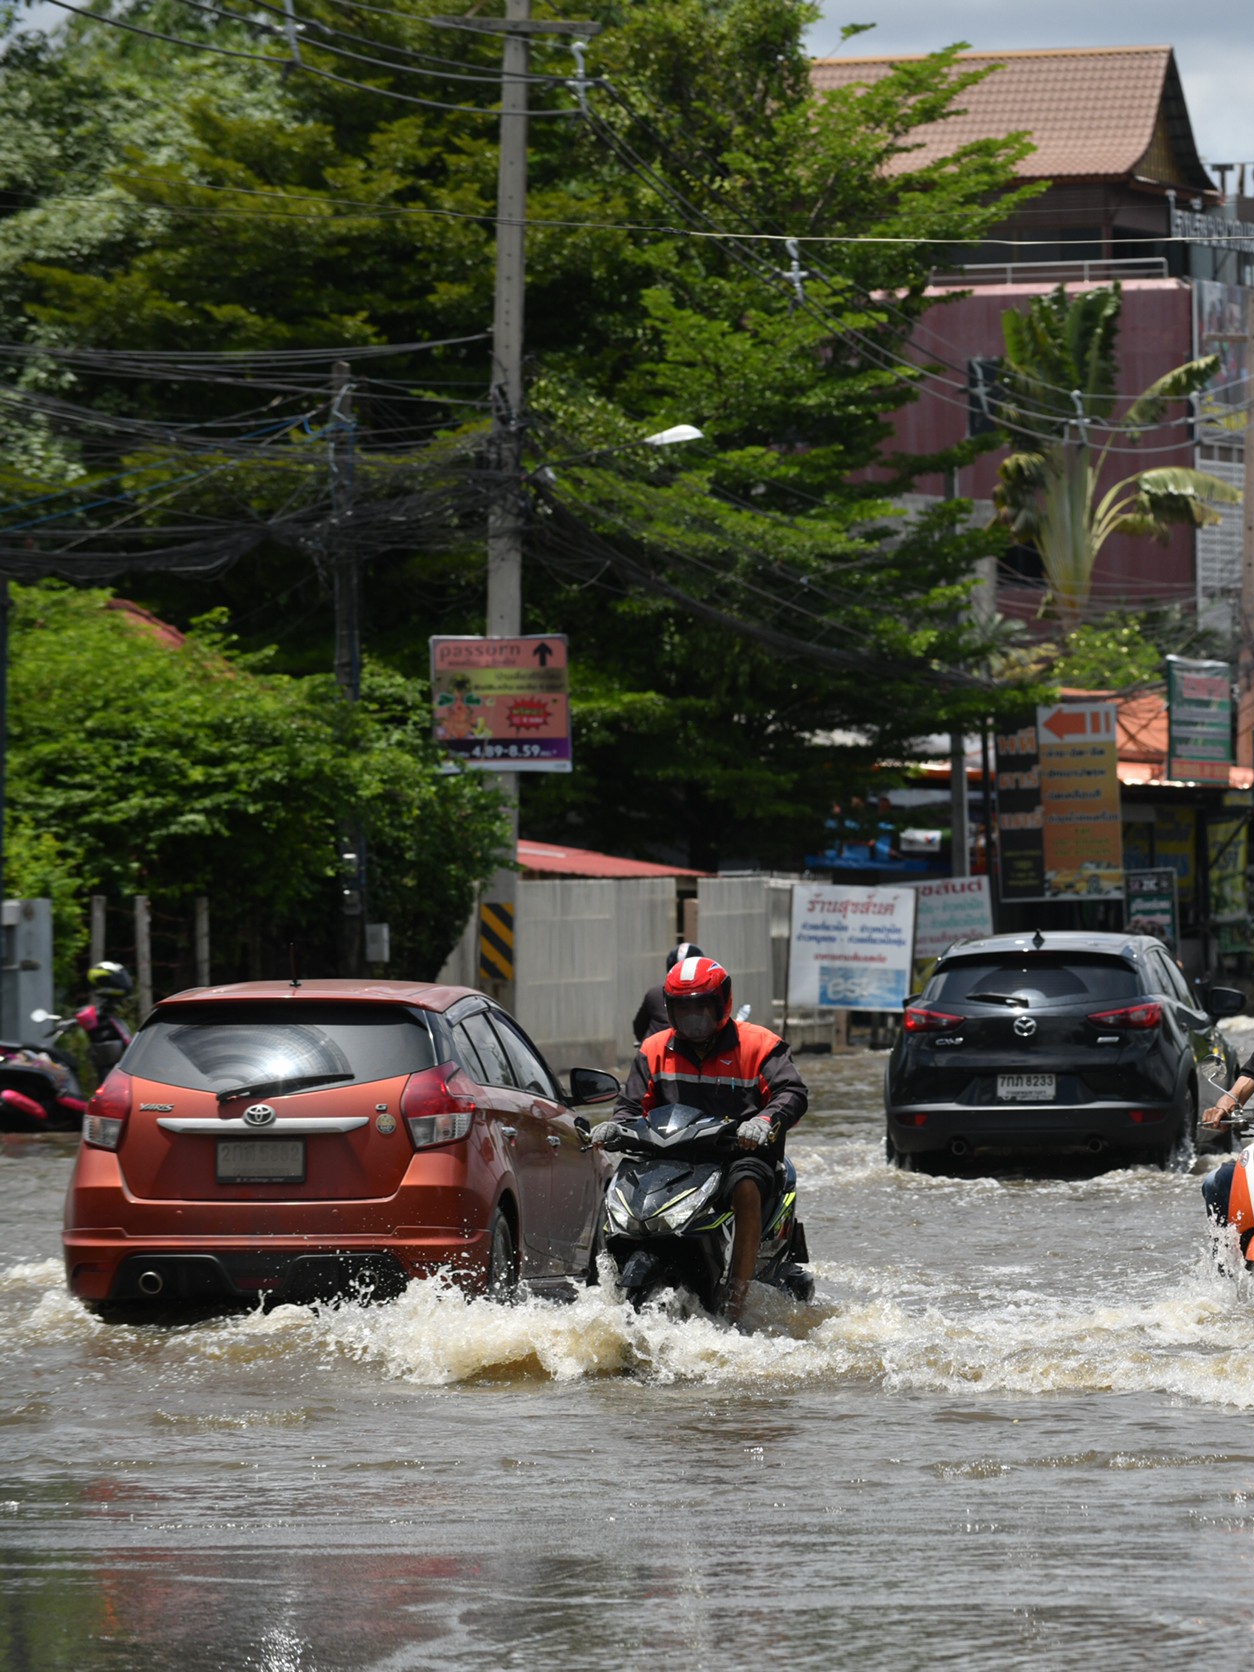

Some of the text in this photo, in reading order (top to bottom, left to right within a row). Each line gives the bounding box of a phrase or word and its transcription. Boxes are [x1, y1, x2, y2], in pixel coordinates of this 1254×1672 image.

[440, 644, 521, 662] passorn
[807, 892, 899, 917] ร้านสุขสันต์
[1026, 1075, 1054, 1087] 8233
[139, 1103, 175, 1112] YARIS
